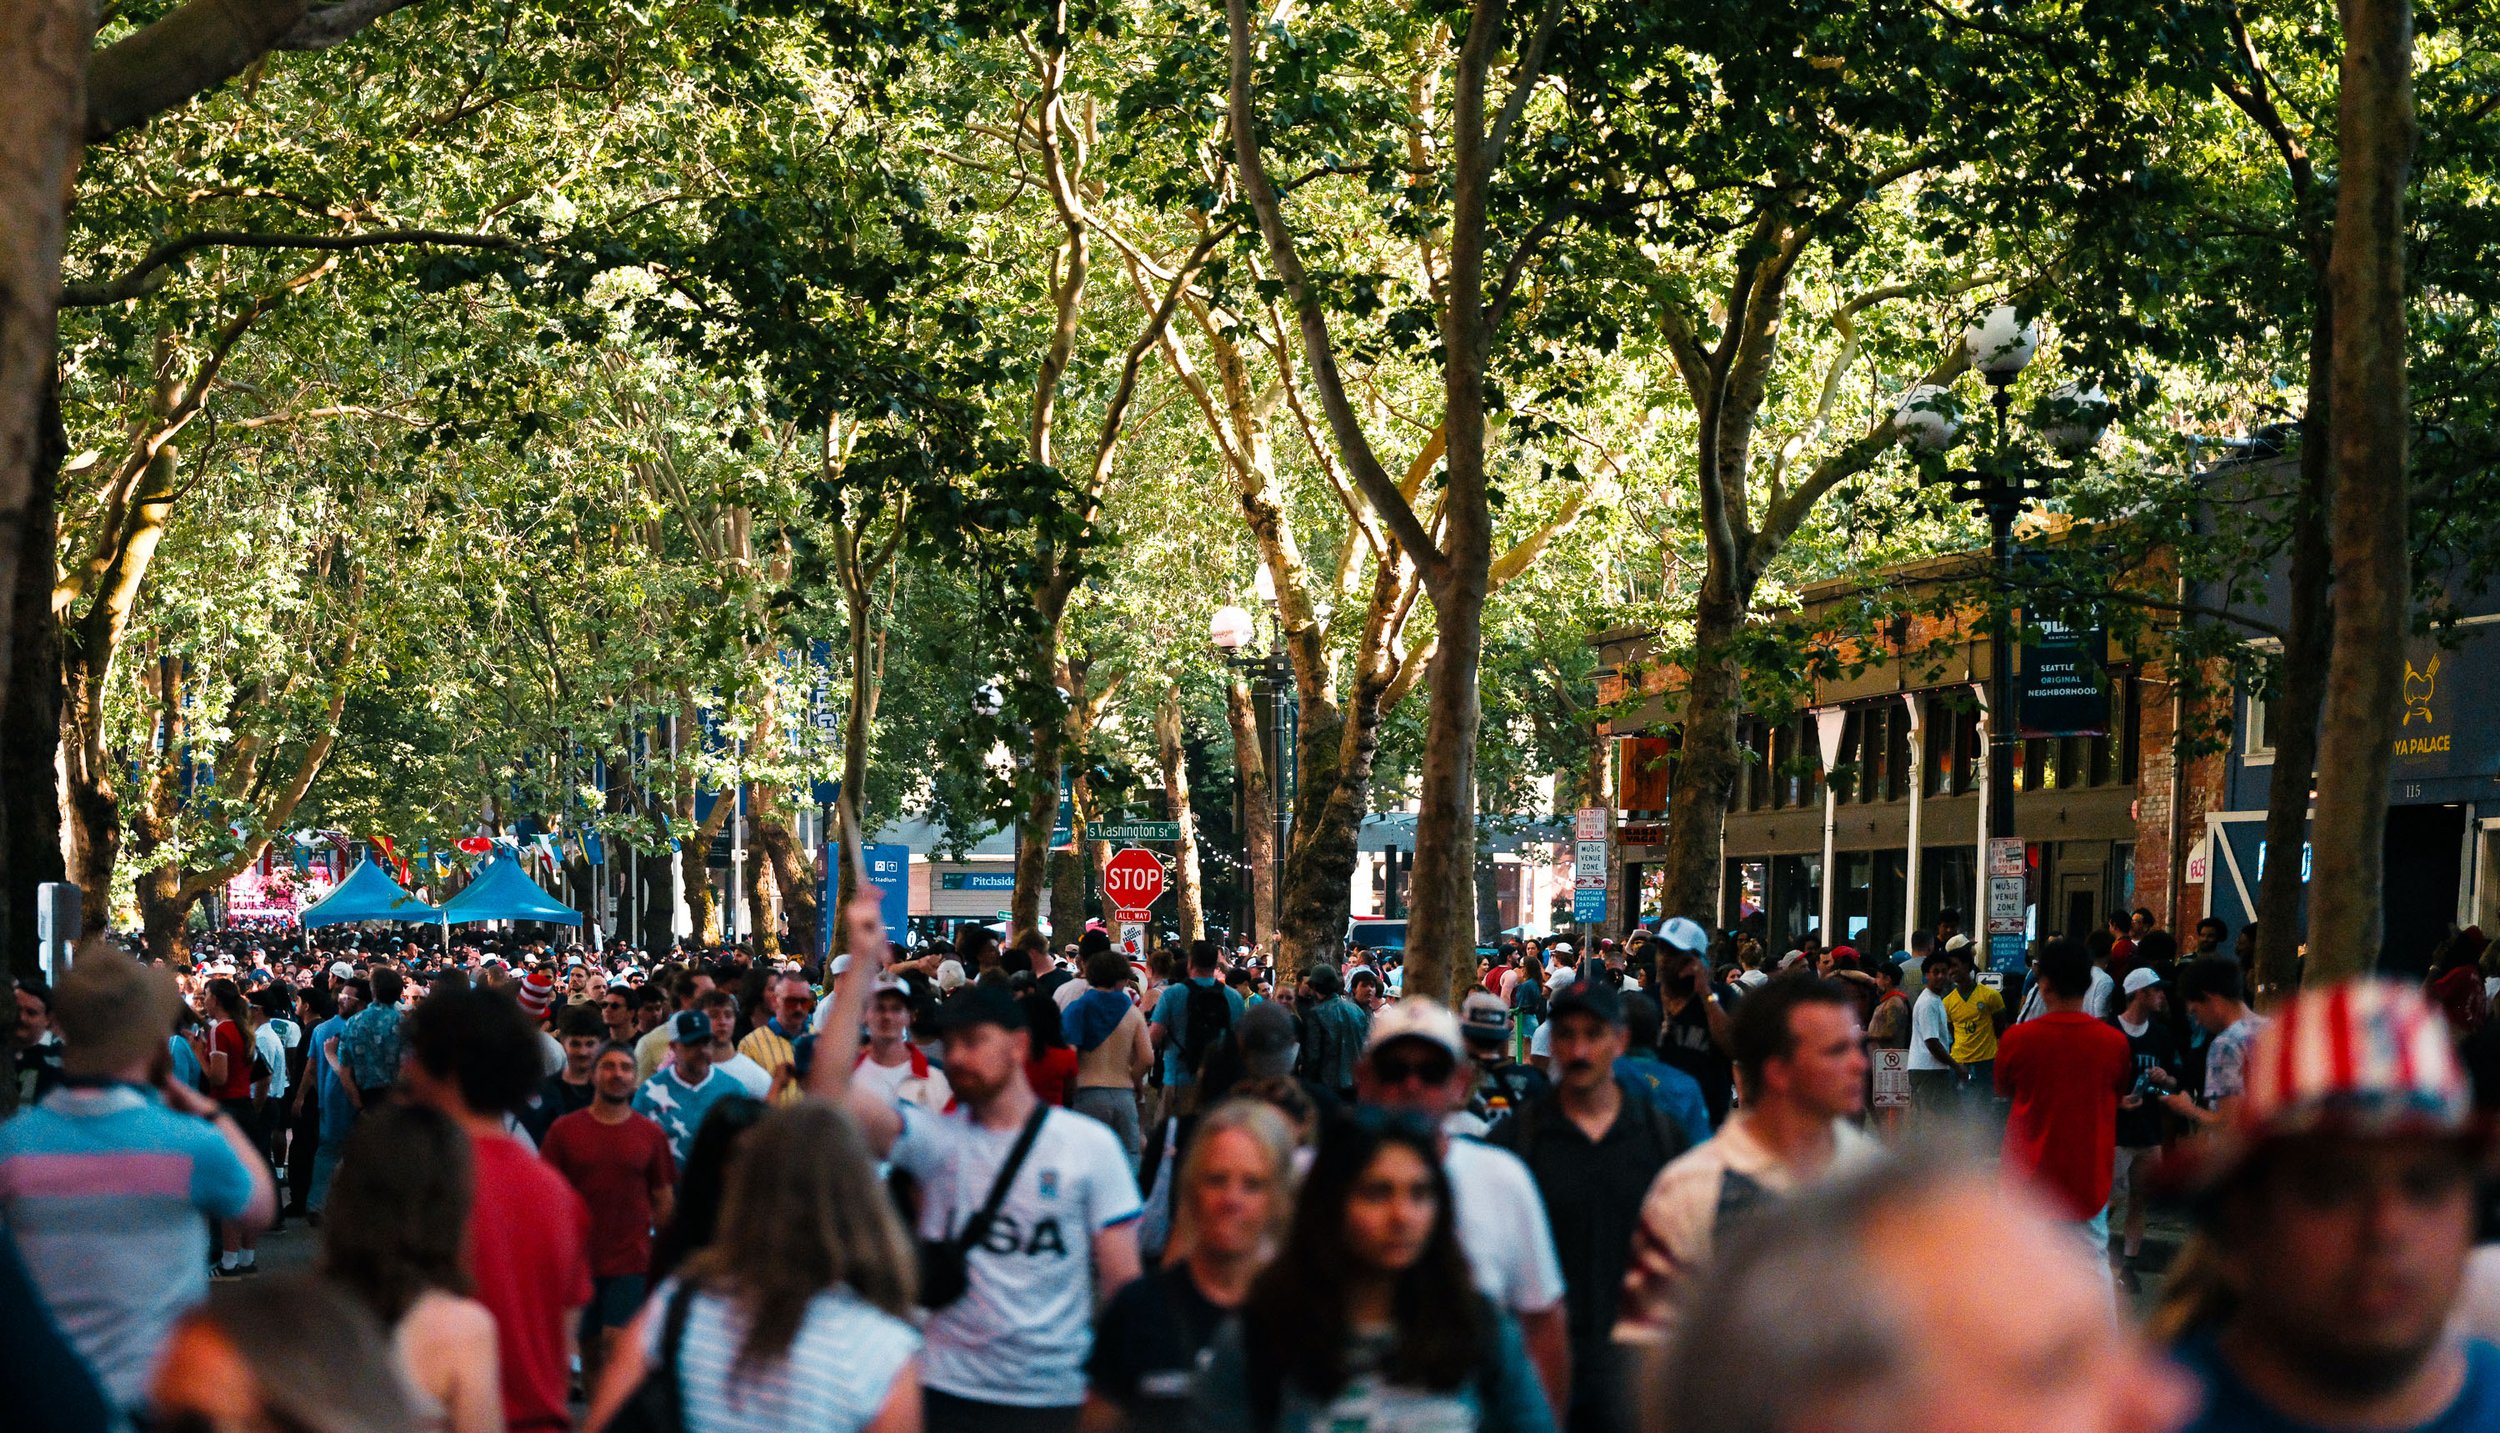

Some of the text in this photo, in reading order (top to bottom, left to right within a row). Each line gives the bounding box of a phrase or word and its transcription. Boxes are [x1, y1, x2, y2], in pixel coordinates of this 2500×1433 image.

[2040, 663, 2075, 672] SEATTLE
[2041, 676, 2081, 684] ORIGINAL
[2028, 688, 2098, 697] NEIGHBORHOOD
[2410, 735, 2451, 755] PALACE
[2406, 784, 2421, 798] 115
[1089, 827, 1096, 837] S
[1097, 823, 1156, 839] Washington
[1158, 826, 1168, 837] St
[1581, 845, 1601, 853] MUSIC
[1580, 854, 1601, 862] VENUE
[1582, 863, 1599, 871] ZONE
[972, 876, 1015, 886] Pitchside
[1108, 867, 1160, 891] STOP
[1995, 882, 2018, 890] MUSIC
[1995, 892, 2018, 901] VENUE
[1996, 903, 2016, 911] ZONE
[1118, 912, 1148, 920] ALL WAY
[986, 1215, 1069, 1258] SA
